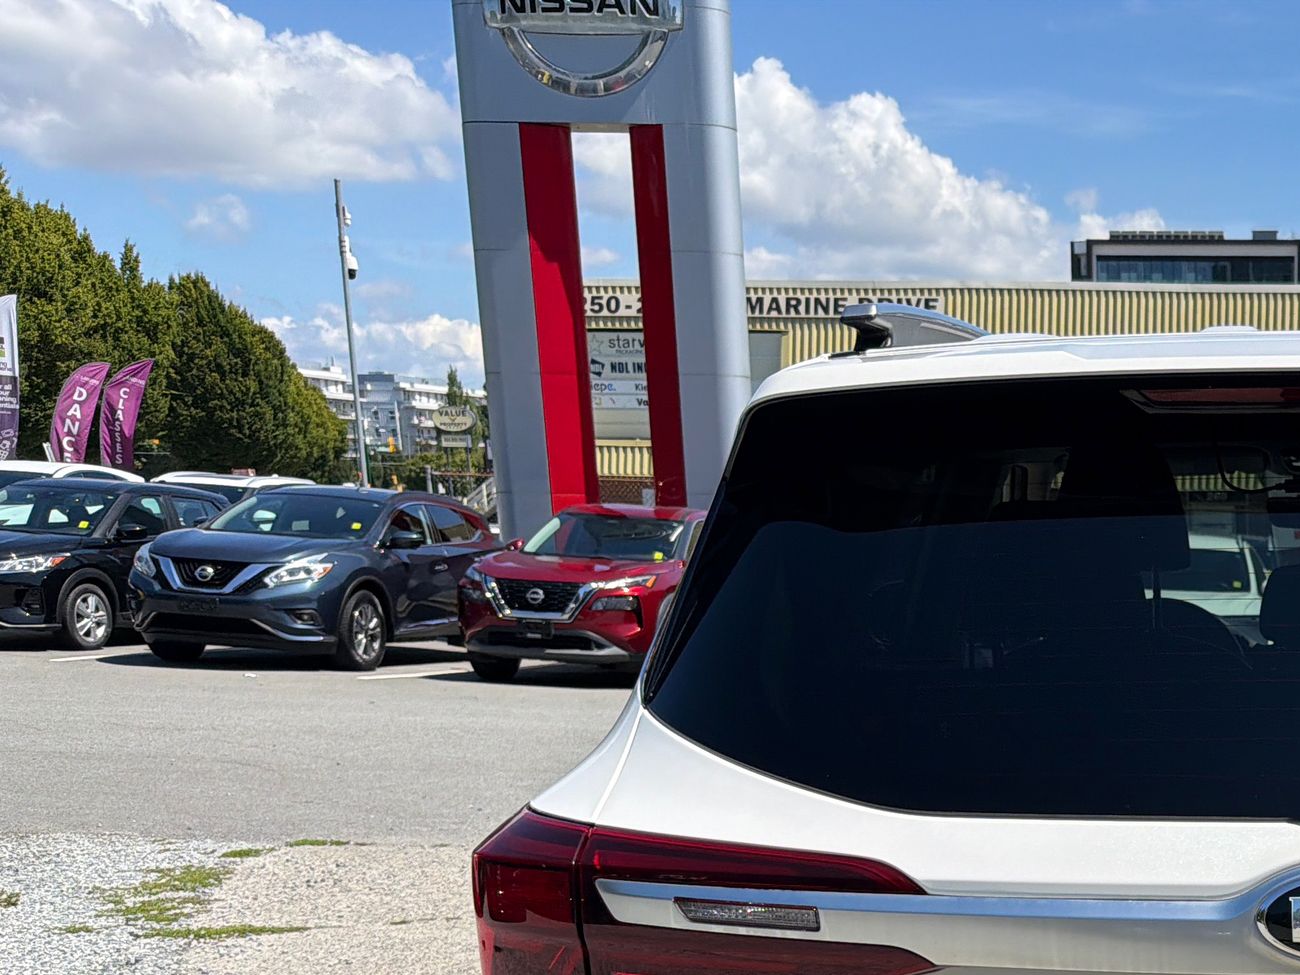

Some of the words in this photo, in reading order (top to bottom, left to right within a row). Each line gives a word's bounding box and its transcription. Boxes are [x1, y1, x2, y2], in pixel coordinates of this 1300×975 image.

[746, 297, 849, 315] MARINE
[610, 362, 630, 373] NDL
[113, 387, 130, 465] CLASSES
